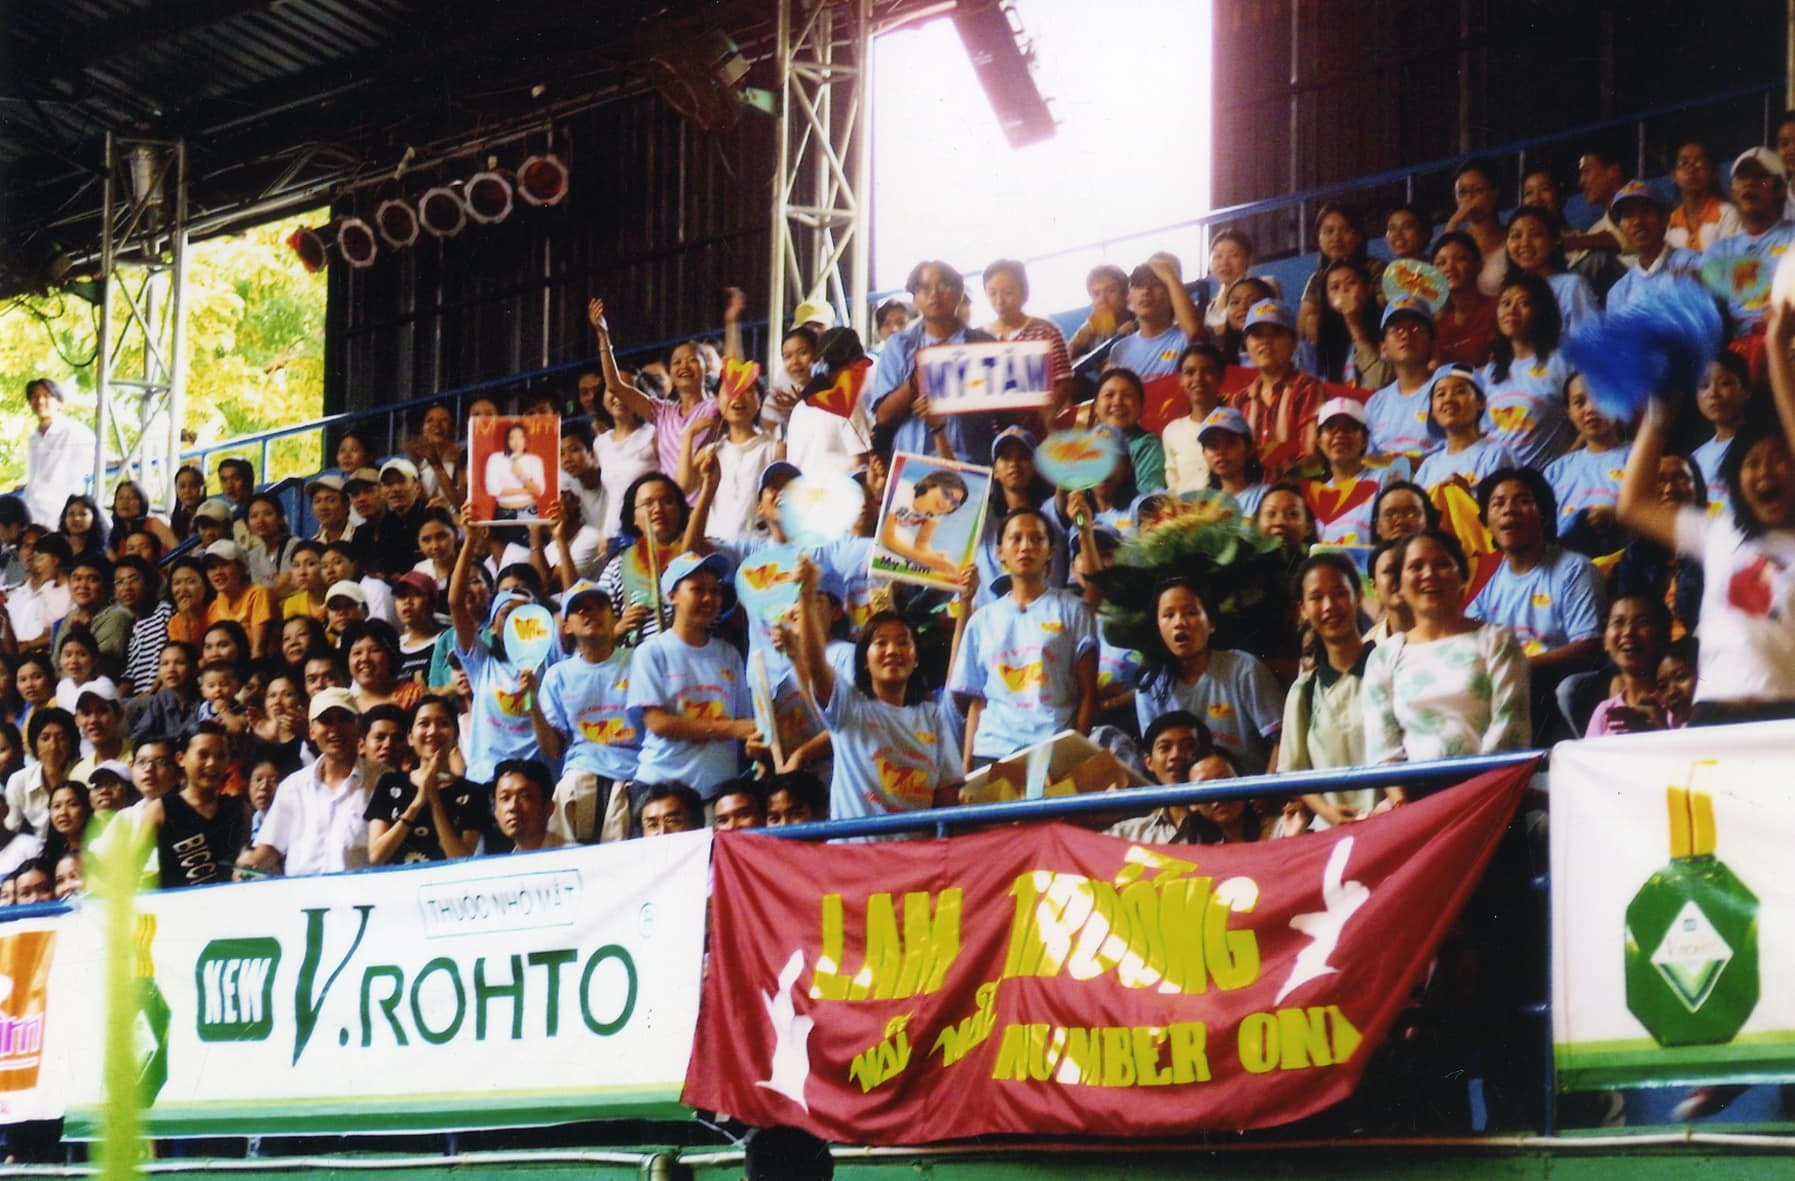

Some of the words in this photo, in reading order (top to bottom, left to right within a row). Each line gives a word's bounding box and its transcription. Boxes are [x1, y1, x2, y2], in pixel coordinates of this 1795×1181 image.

[809, 887, 963, 1001] LAM
[204, 957, 272, 1024] NEW
[992, 1022, 1211, 1087] NUMBER
